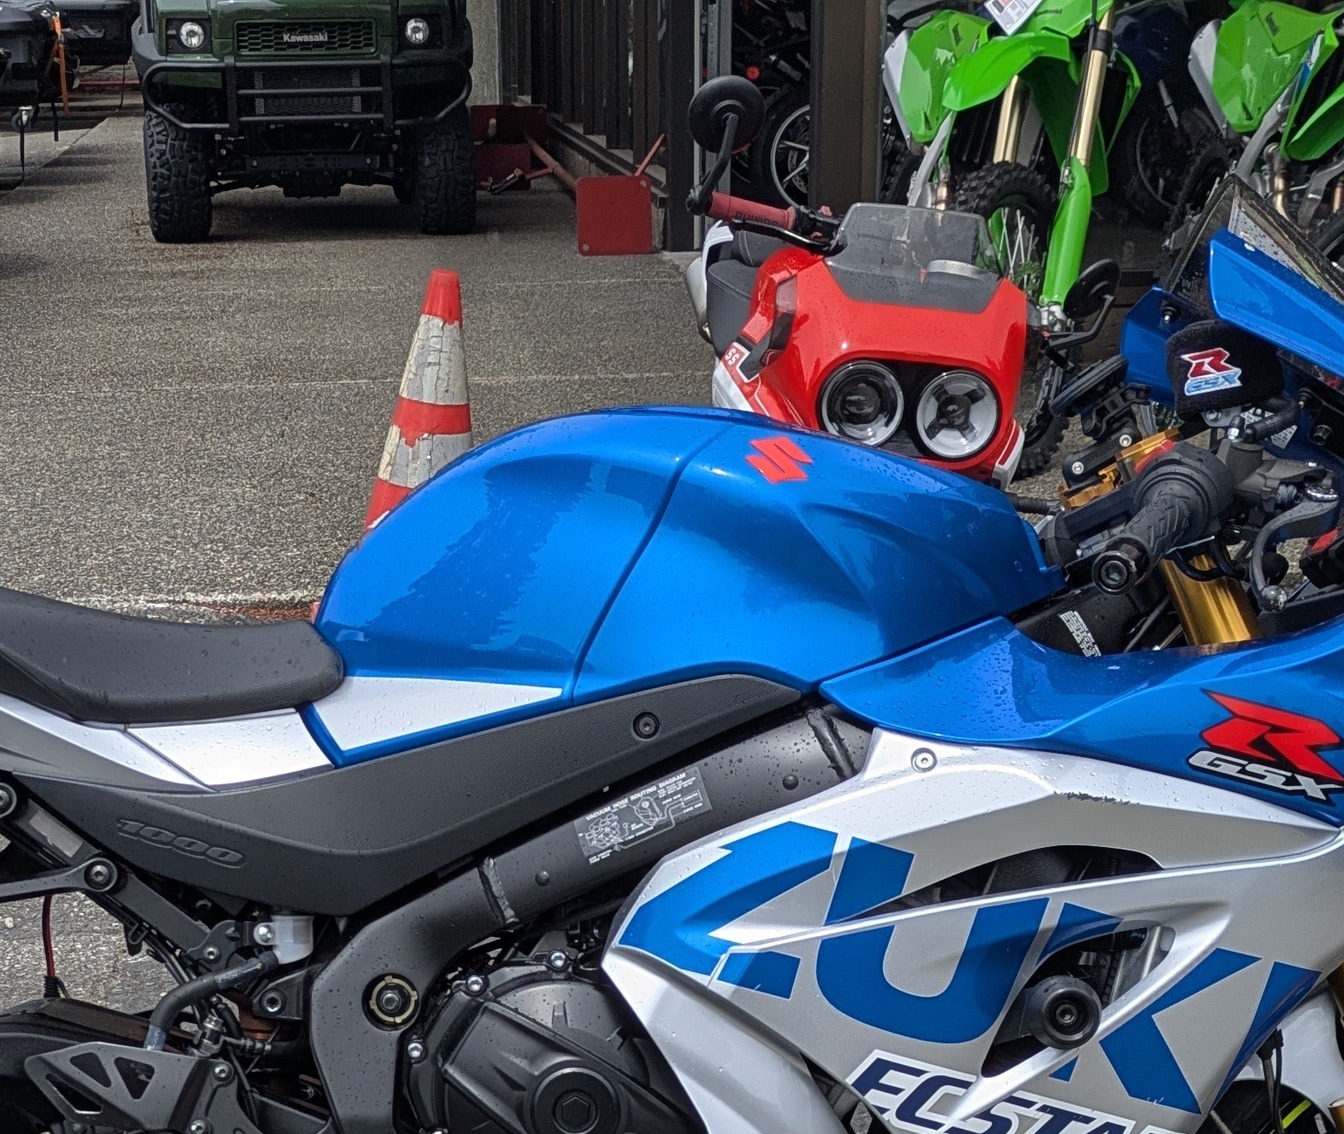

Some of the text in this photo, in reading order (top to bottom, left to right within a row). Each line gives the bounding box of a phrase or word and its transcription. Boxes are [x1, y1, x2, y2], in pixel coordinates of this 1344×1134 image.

[283, 32, 328, 43] Kawasaki
[725, 348, 740, 366] SS
[585, 806, 612, 821] VACUUM
[630, 786, 657, 801] ROUTING
[658, 772, 687, 788] DIAGRAM
[1187, 750, 1344, 801] GSX
[117, 818, 246, 867] 1000
